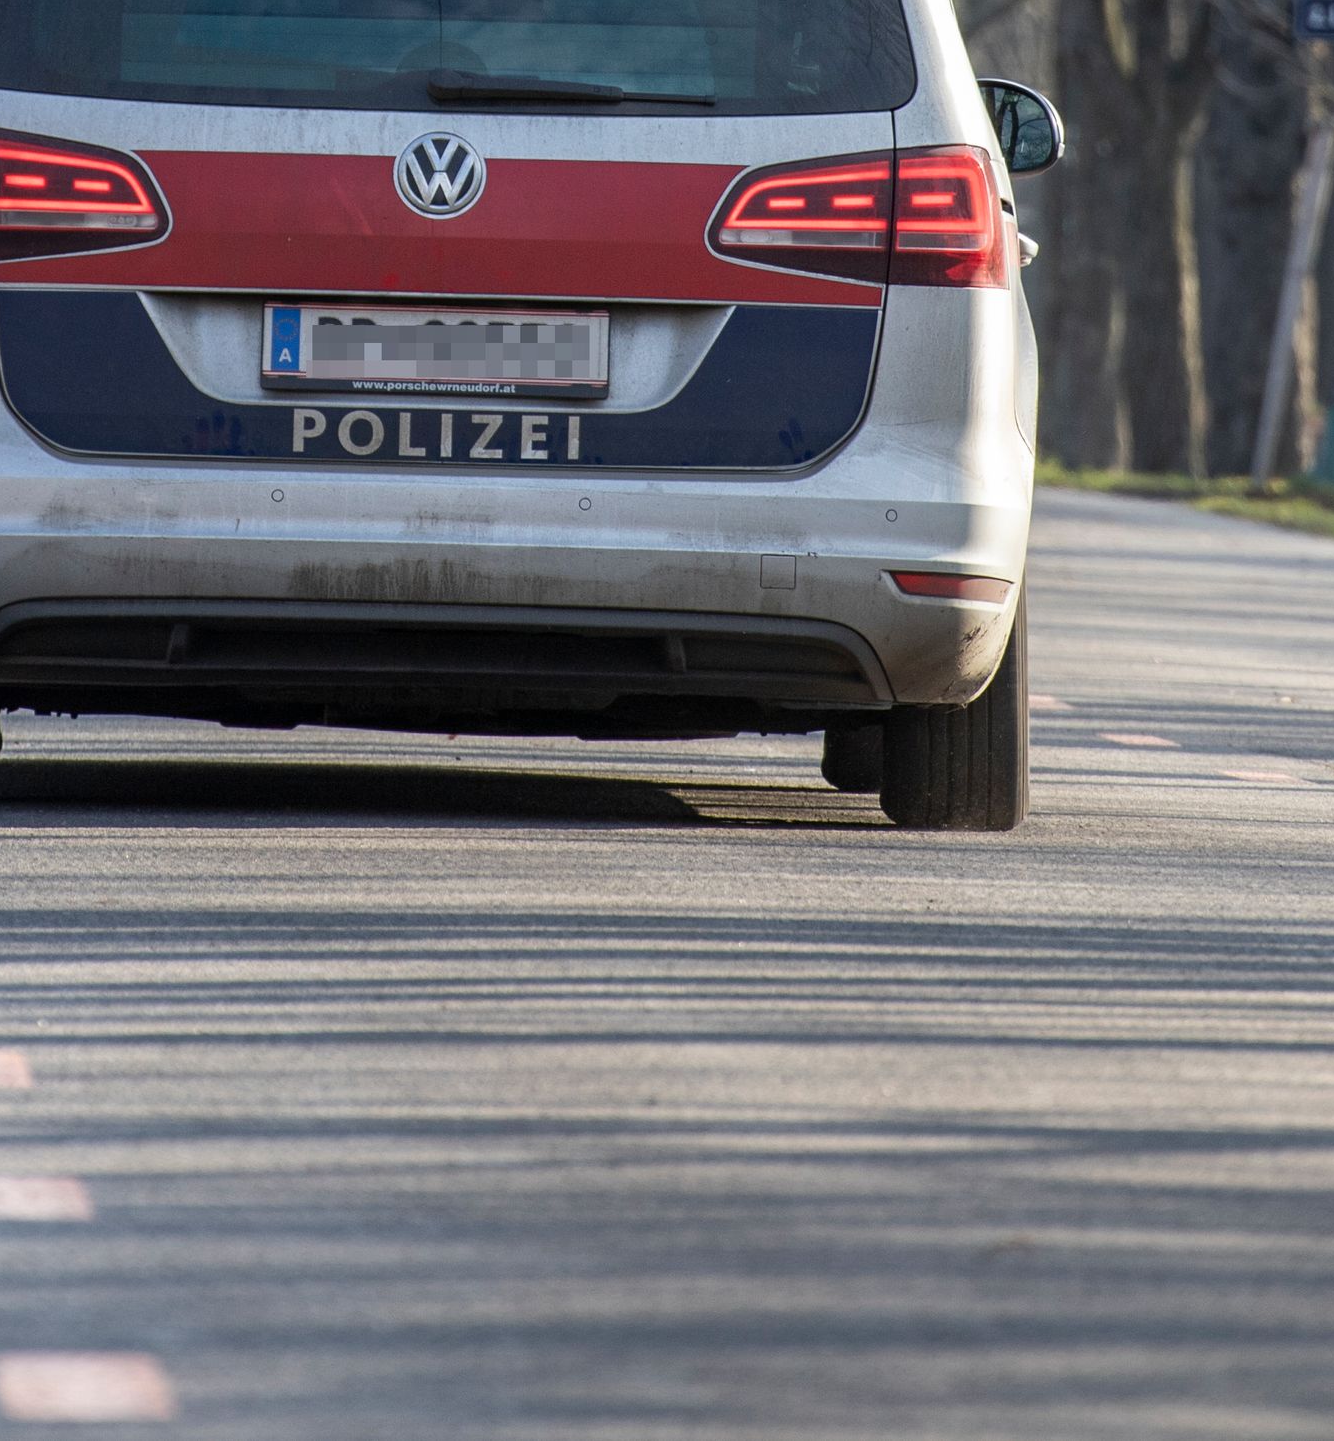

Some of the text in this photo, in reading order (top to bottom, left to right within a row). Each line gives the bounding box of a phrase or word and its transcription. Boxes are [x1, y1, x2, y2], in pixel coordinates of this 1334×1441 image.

[402, 136, 478, 210] VW
[279, 348, 292, 362] A
[352, 380, 516, 394] www.porschewrneudorf.at
[292, 408, 580, 460] POLIZEI
